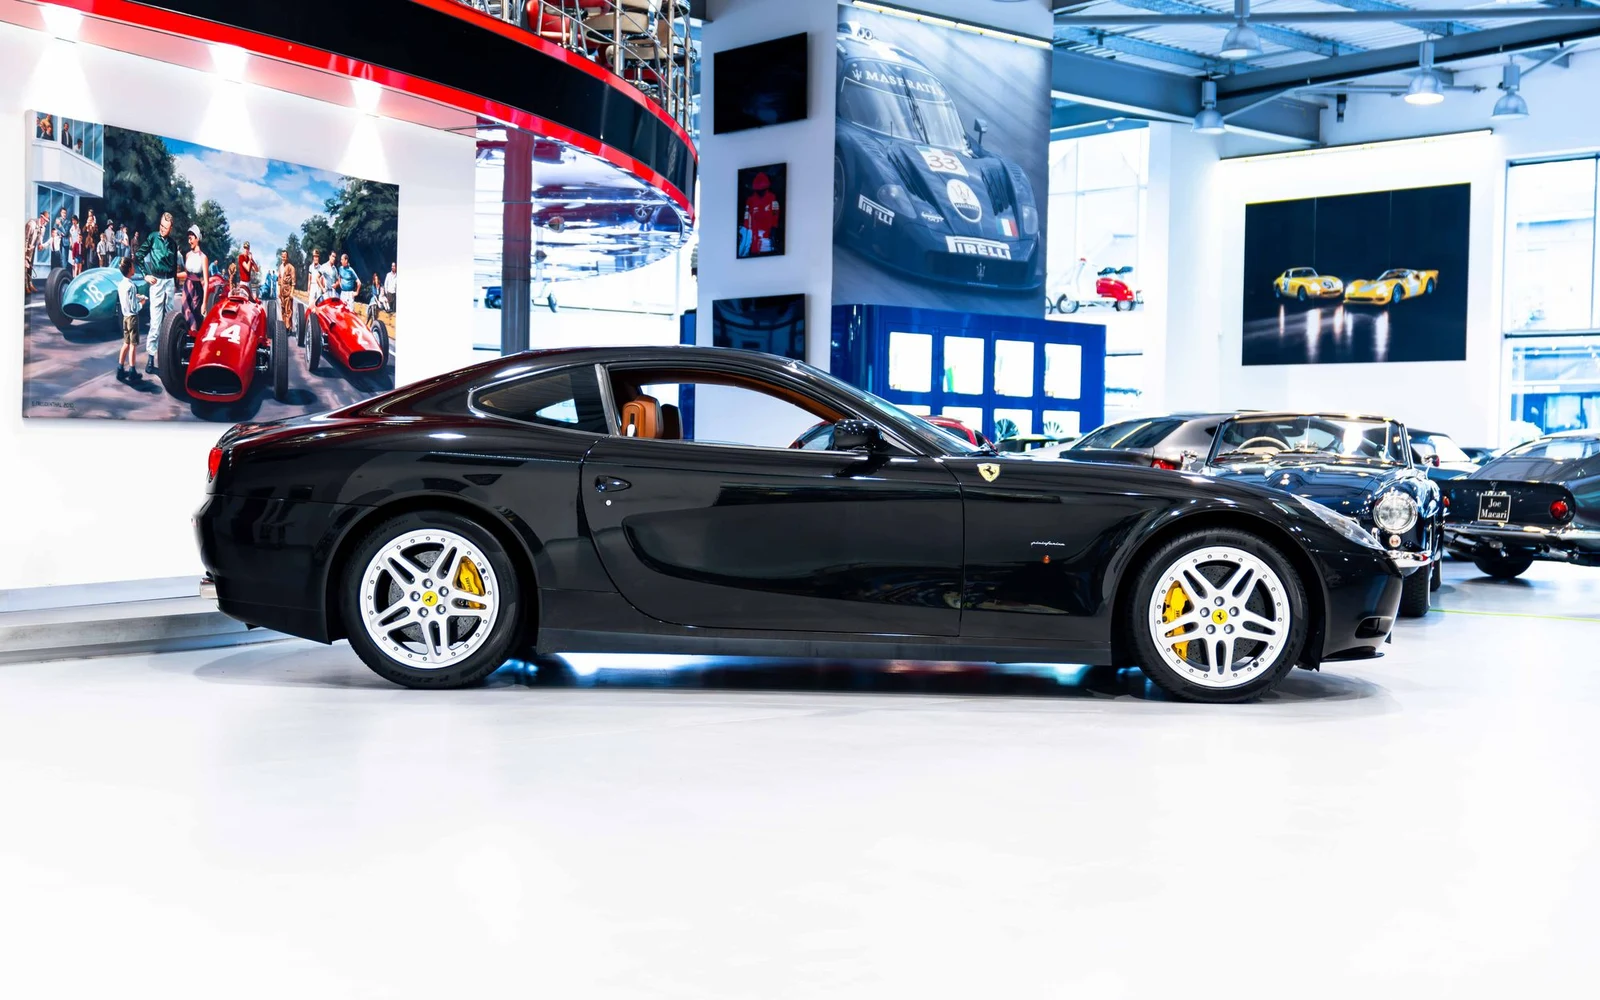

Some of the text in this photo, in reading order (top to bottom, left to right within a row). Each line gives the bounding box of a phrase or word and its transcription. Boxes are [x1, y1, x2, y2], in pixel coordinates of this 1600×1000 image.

[865, 70, 936, 95] MASERATI
[928, 155, 958, 170] 33
[945, 235, 1012, 260] PIRELLI
[83, 280, 105, 304] 18
[201, 322, 241, 345] 14
[1480, 508, 1508, 519] Macari
[1488, 498, 1502, 508] Joe
